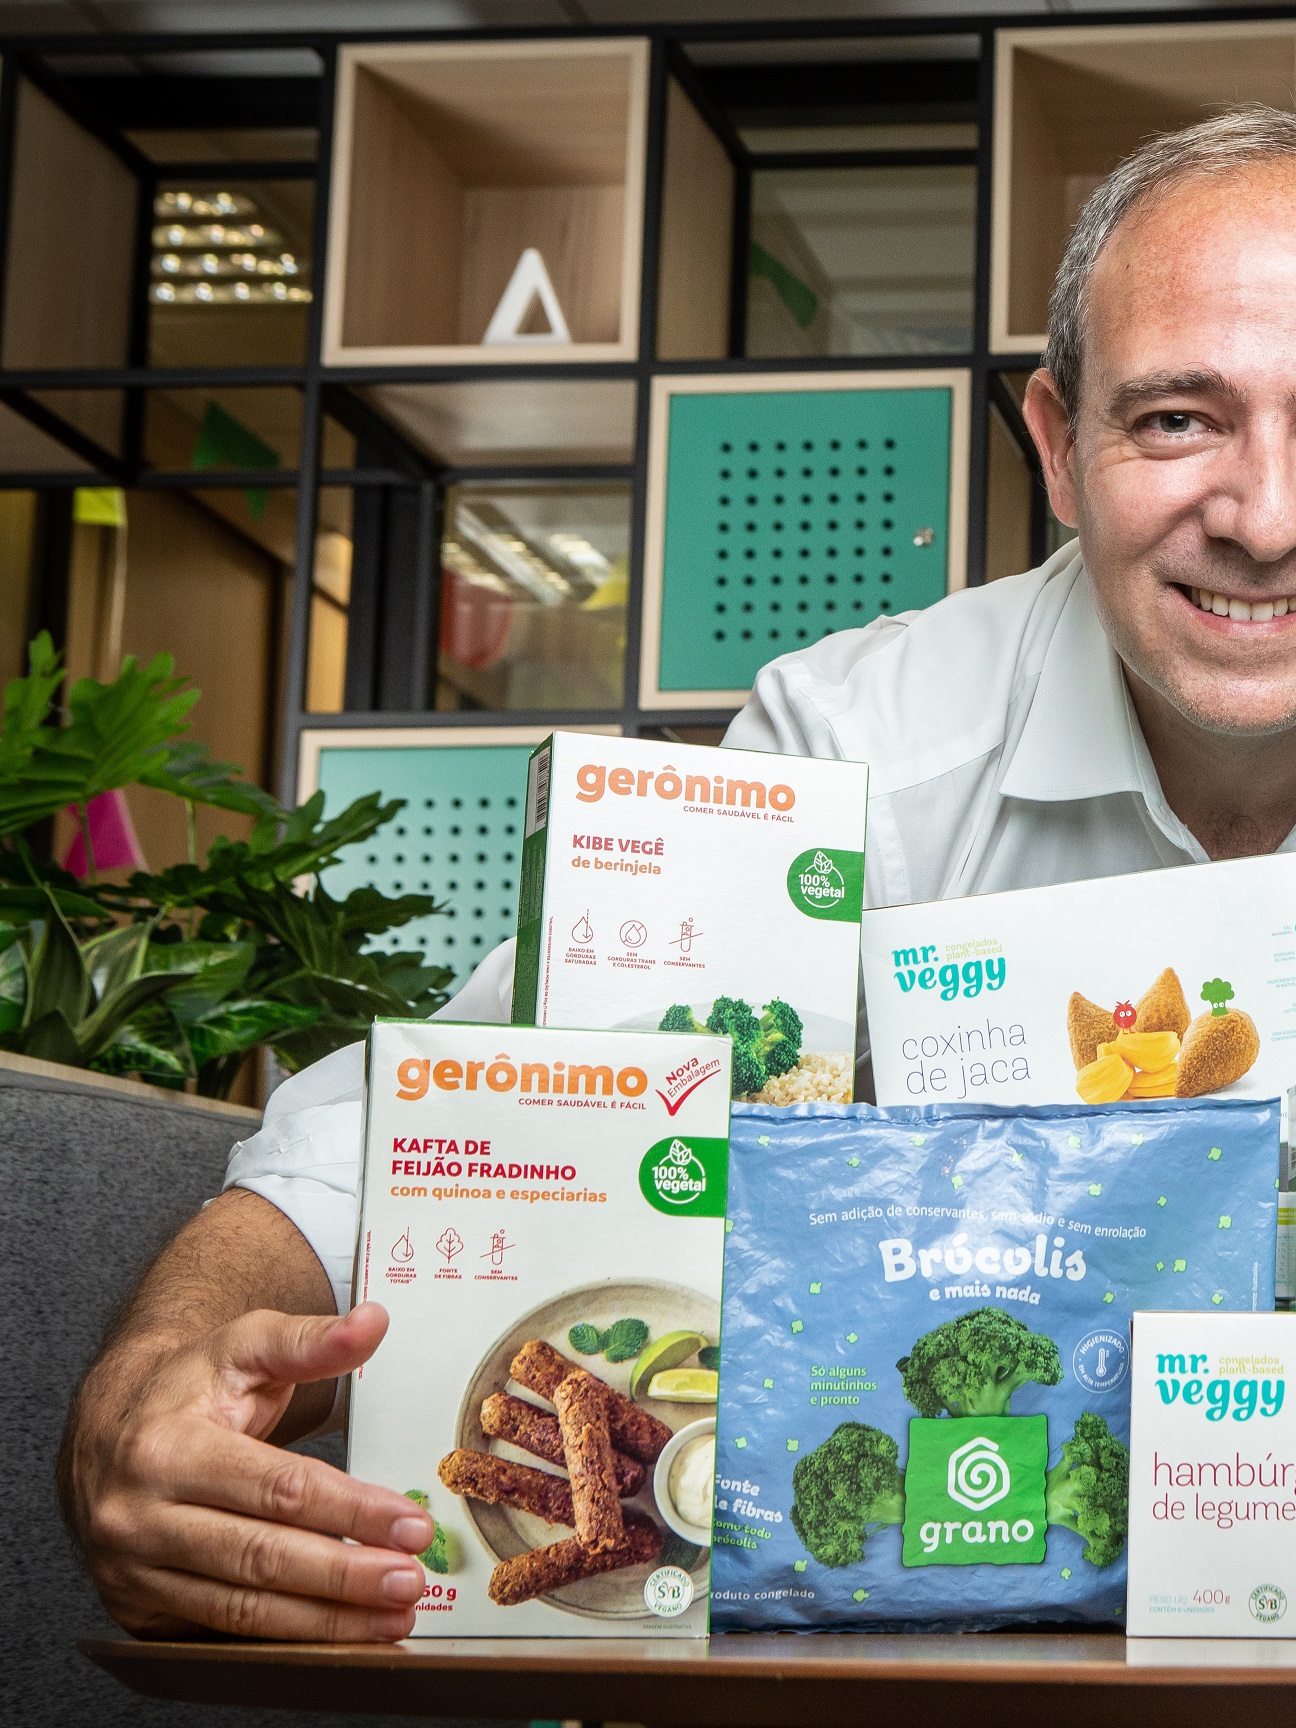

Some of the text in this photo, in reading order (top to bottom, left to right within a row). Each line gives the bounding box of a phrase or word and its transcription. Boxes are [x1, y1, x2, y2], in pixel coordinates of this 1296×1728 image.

[576, 764, 796, 812] gerônimo
[683, 805, 795, 823] COMER SAUDÁVEL É FÁCIL
[572, 834, 665, 856] KIBE VEGÊ
[571, 856, 662, 876] de berinjela
[799, 873, 830, 888] 100%
[801, 884, 845, 900] vegetal
[945, 938, 998, 952] congelados
[891, 944, 939, 968] mr.
[894, 957, 1006, 1002] veggy
[902, 1018, 1027, 1061] coxinha
[396, 1052, 649, 1101] gerônimo
[665, 1055, 700, 1086] Nova
[666, 1059, 721, 1099] Embalagem
[906, 1057, 1031, 1099] de jaca
[518, 1097, 647, 1110] COMER SAUDÁVEL É FÁCIL
[393, 1137, 491, 1156] KAFTA DE
[391, 1157, 577, 1181] FEIJÃO FRADINHO
[652, 1166, 689, 1180] 100%
[390, 1183, 608, 1204] com quinoa e especiarias
[654, 1177, 706, 1193] vegetal
[809, 1204, 1147, 1241] Sem adição de conservantes, sem sódio e sem enrolação
[878, 1232, 1087, 1283] Brócolis
[929, 1279, 1041, 1306] e mais nada
[1080, 1335, 1124, 1355] HIGIENIZADO
[810, 1365, 867, 1379] Só alguns
[1155, 1353, 1210, 1375] mr.
[1219, 1354, 1280, 1369] congelados
[1219, 1364, 1284, 1377] plant-based
[810, 1380, 877, 1391] minutinhos
[810, 1395, 860, 1407] e pronto
[1154, 1379, 1286, 1422] veggy
[732, 1498, 783, 1523] fibras
[1152, 1493, 1185, 1521] de
[713, 1519, 772, 1540] omo todo
[920, 1518, 1035, 1553] grano
[446, 1588, 457, 1601] g
[710, 1588, 815, 1600] roduto congelado
[415, 1602, 453, 1611] nidades
